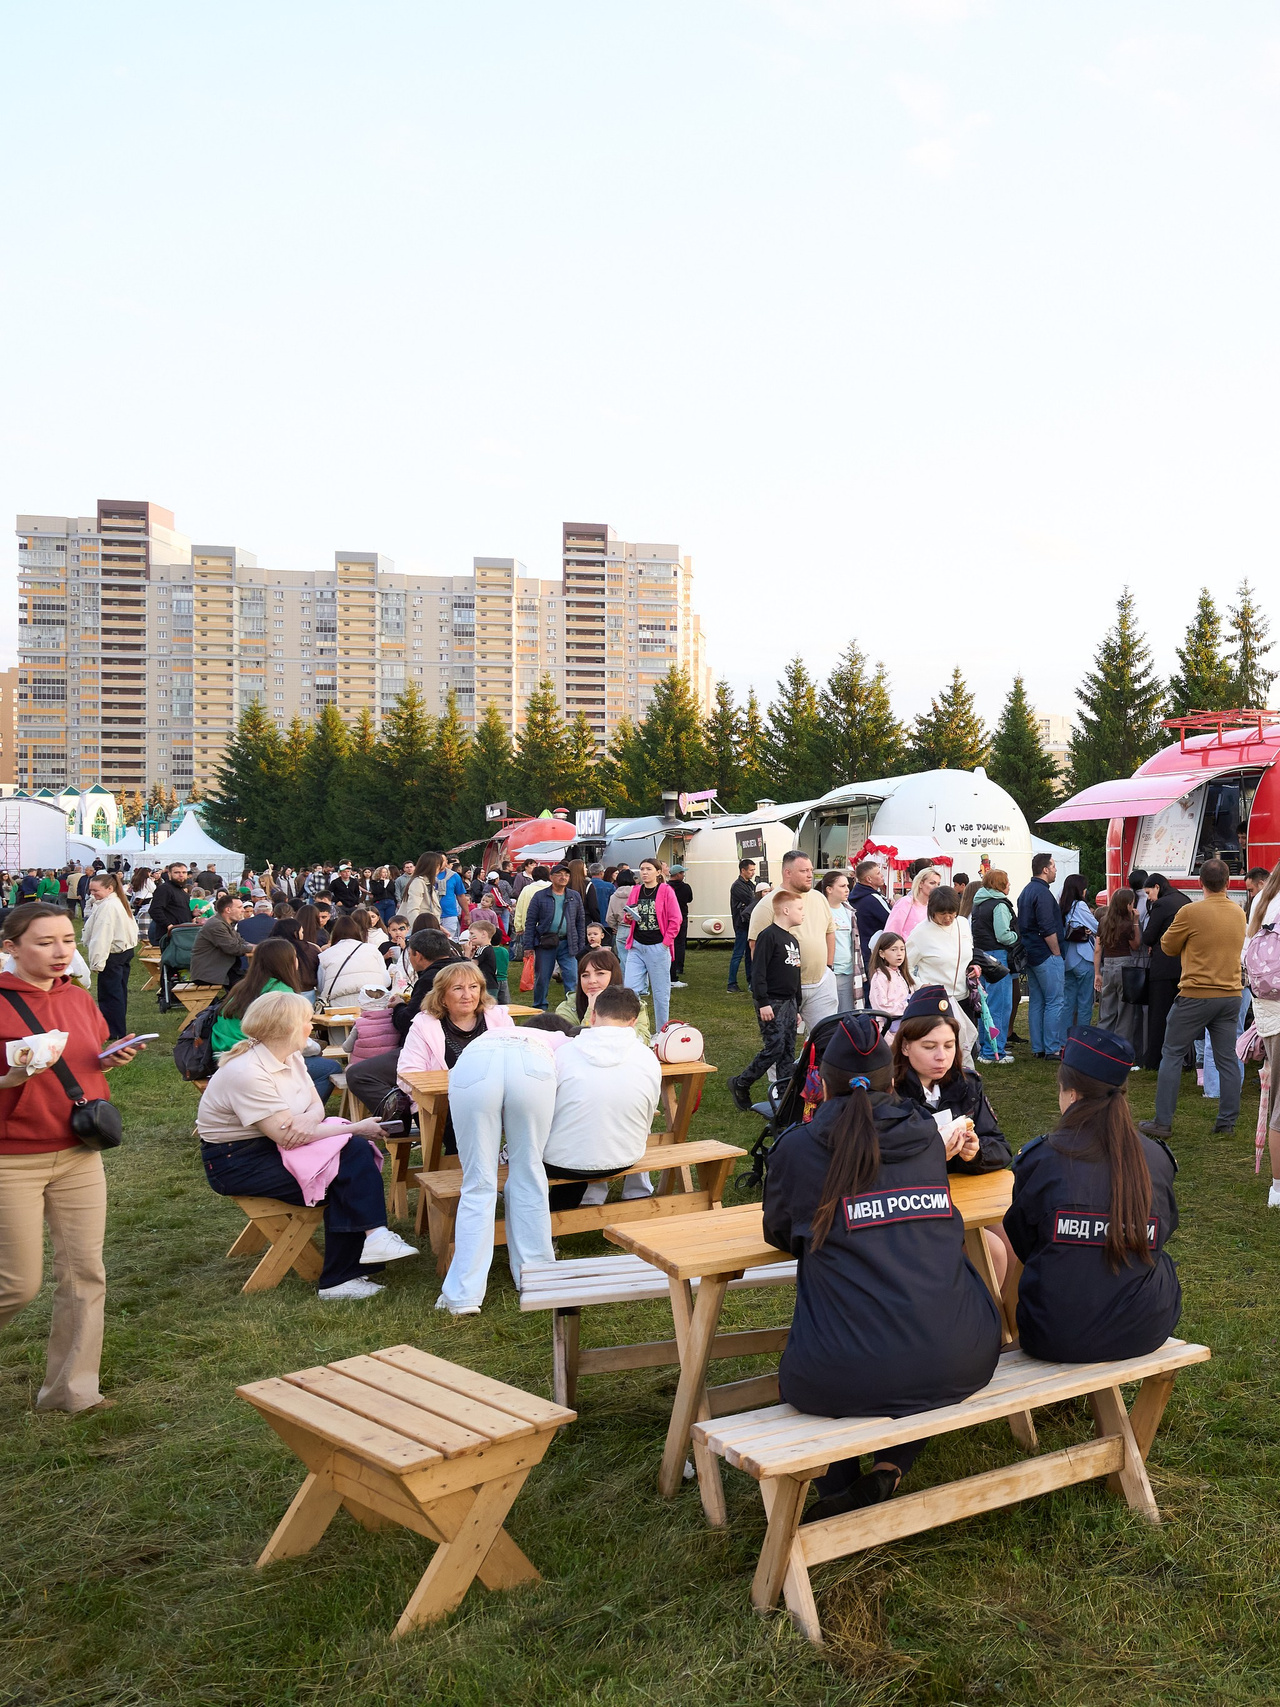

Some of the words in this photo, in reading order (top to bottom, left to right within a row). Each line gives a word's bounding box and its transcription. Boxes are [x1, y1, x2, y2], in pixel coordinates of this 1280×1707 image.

[945, 823, 956, 833] От
[847, 1199, 885, 1220] МВД
[886, 1193, 950, 1214] РОССИИ
[1057, 1218, 1090, 1239] МВД
